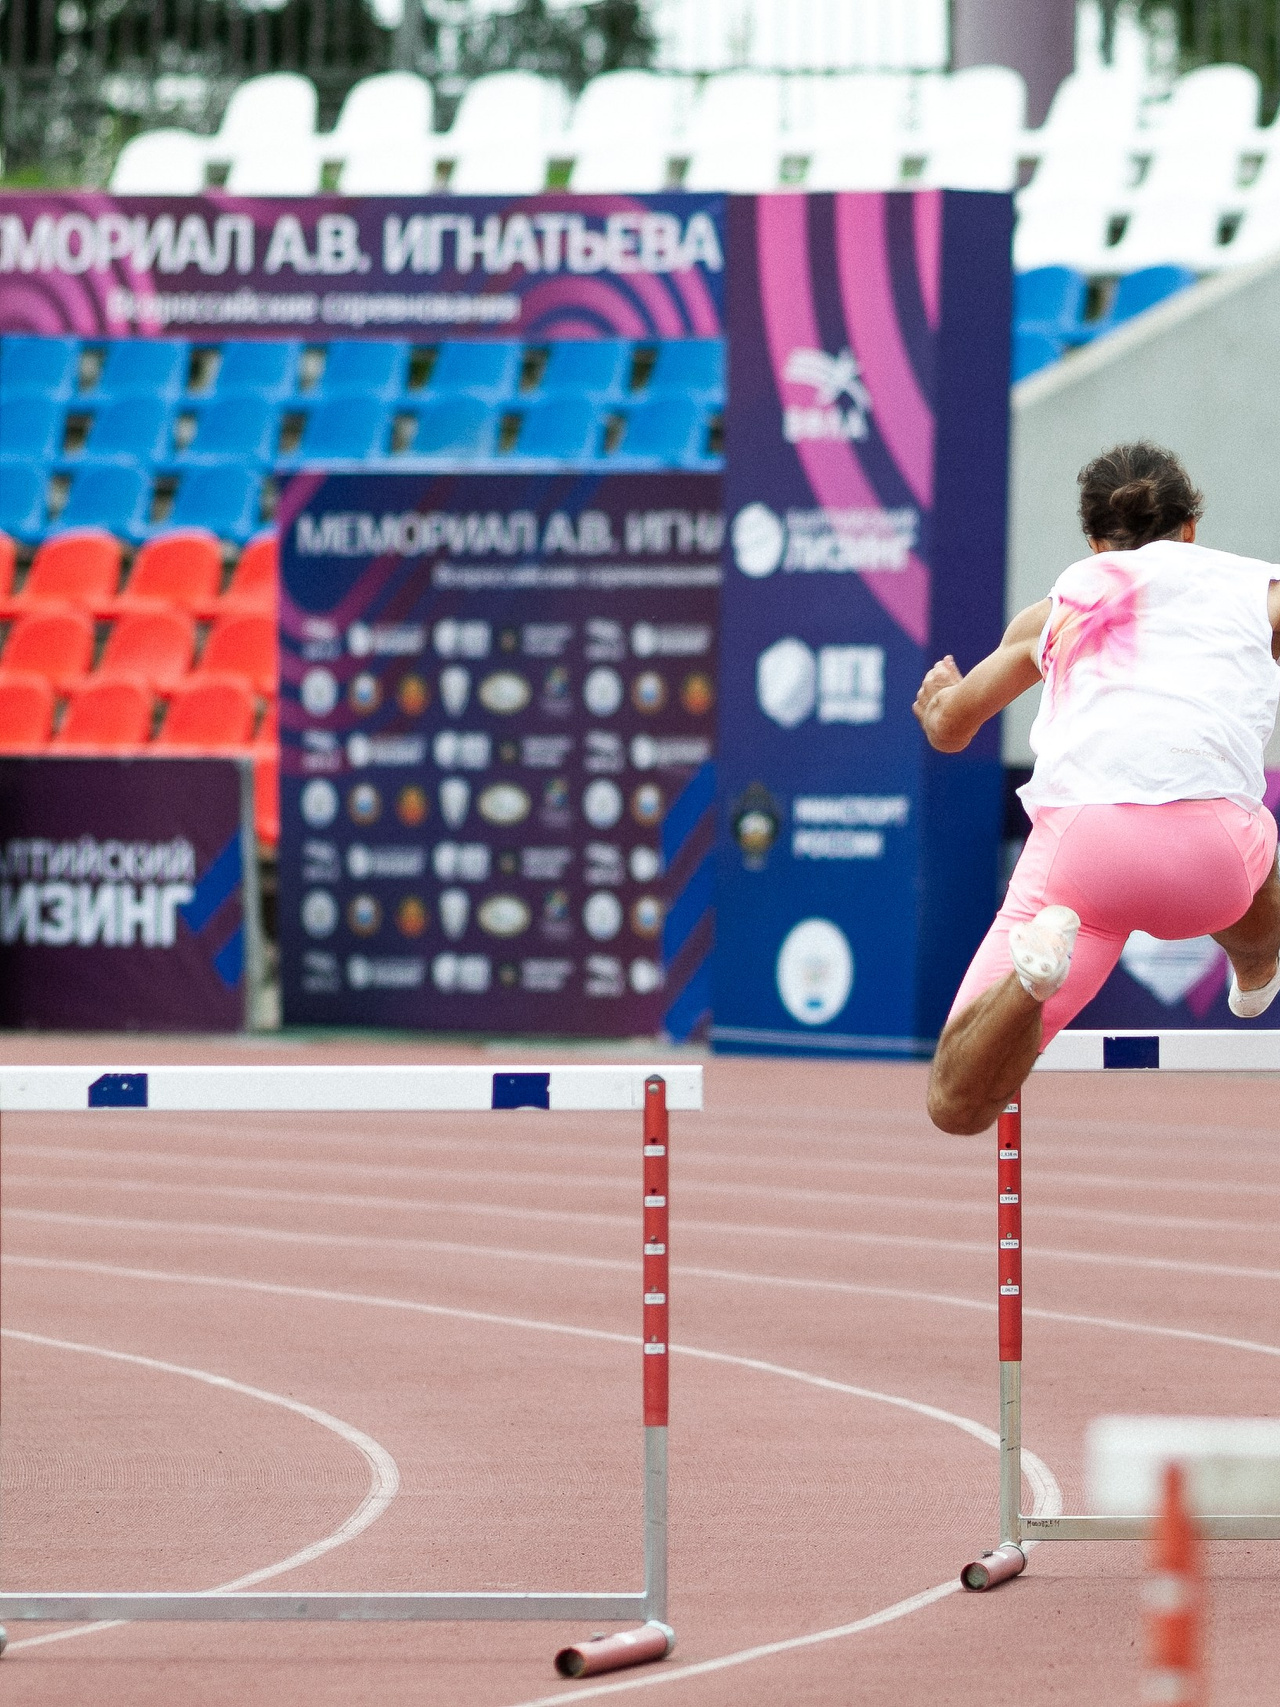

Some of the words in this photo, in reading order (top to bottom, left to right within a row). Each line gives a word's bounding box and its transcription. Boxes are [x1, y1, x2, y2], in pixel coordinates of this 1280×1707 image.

[0, 214, 254, 274] МОРИАЛ
[264, 214, 371, 274] А.В.
[384, 213, 724, 273] ИГНАТЬЕВА
[297, 511, 538, 556] МЕМОРИАЛ
[542, 511, 621, 555] А.В.
[0, 835, 197, 883] ЛТИЙСКИЙ
